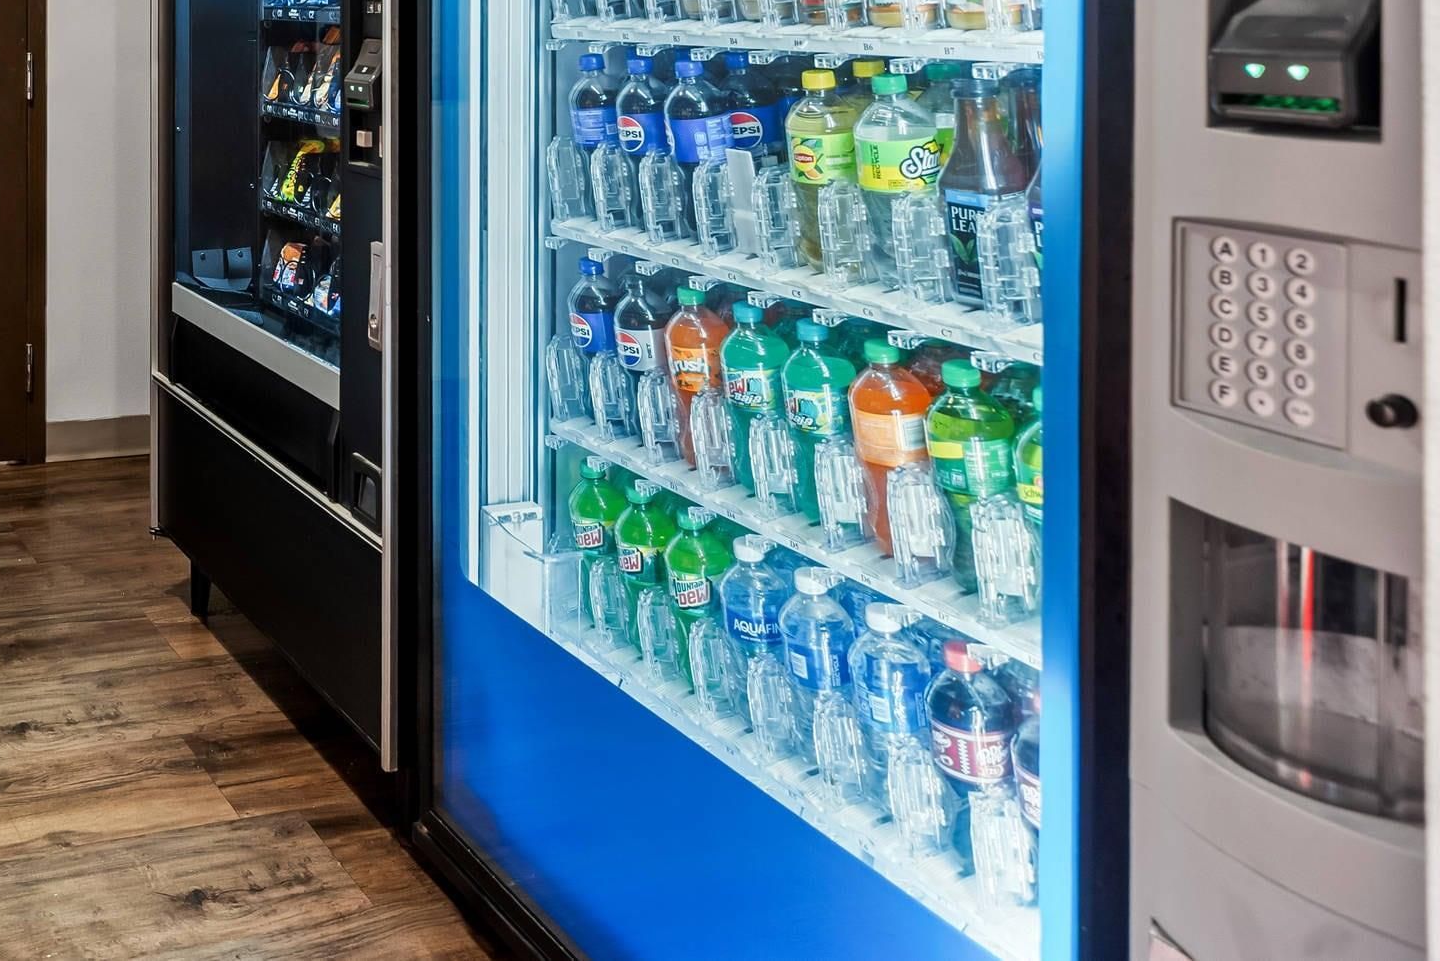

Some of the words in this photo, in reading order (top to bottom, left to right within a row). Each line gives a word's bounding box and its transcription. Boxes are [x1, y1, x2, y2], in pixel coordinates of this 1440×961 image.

[863, 43, 874, 51] B6
[943, 47, 955, 55] B7
[620, 129, 643, 139] EPSI
[731, 124, 761, 136] EPSI
[872, 144, 881, 180] RECYCLE
[952, 220, 978, 234] LEA
[1219, 242, 1233, 257] A
[1258, 248, 1268, 262] 1
[1295, 255, 1308, 269] 2
[727, 273, 736, 281] C4
[1219, 270, 1233, 285] B
[1257, 277, 1269, 292] 3
[1295, 285, 1308, 299] 4
[791, 290, 801, 298] C5
[862, 308, 873, 317] C6
[1219, 300, 1233, 315] C
[1257, 307, 1269, 322] 5
[1295, 315, 1308, 330] 6
[941, 329, 953, 338] C7
[1219, 328, 1233, 343] D
[1257, 336, 1268, 350] 7
[1295, 344, 1307, 359] 8
[1219, 357, 1232, 372] E
[1255, 366, 1268, 381] 9
[1294, 374, 1307, 389] 0
[1219, 385, 1230, 399] F
[733, 618, 781, 637] AQUAFIN
